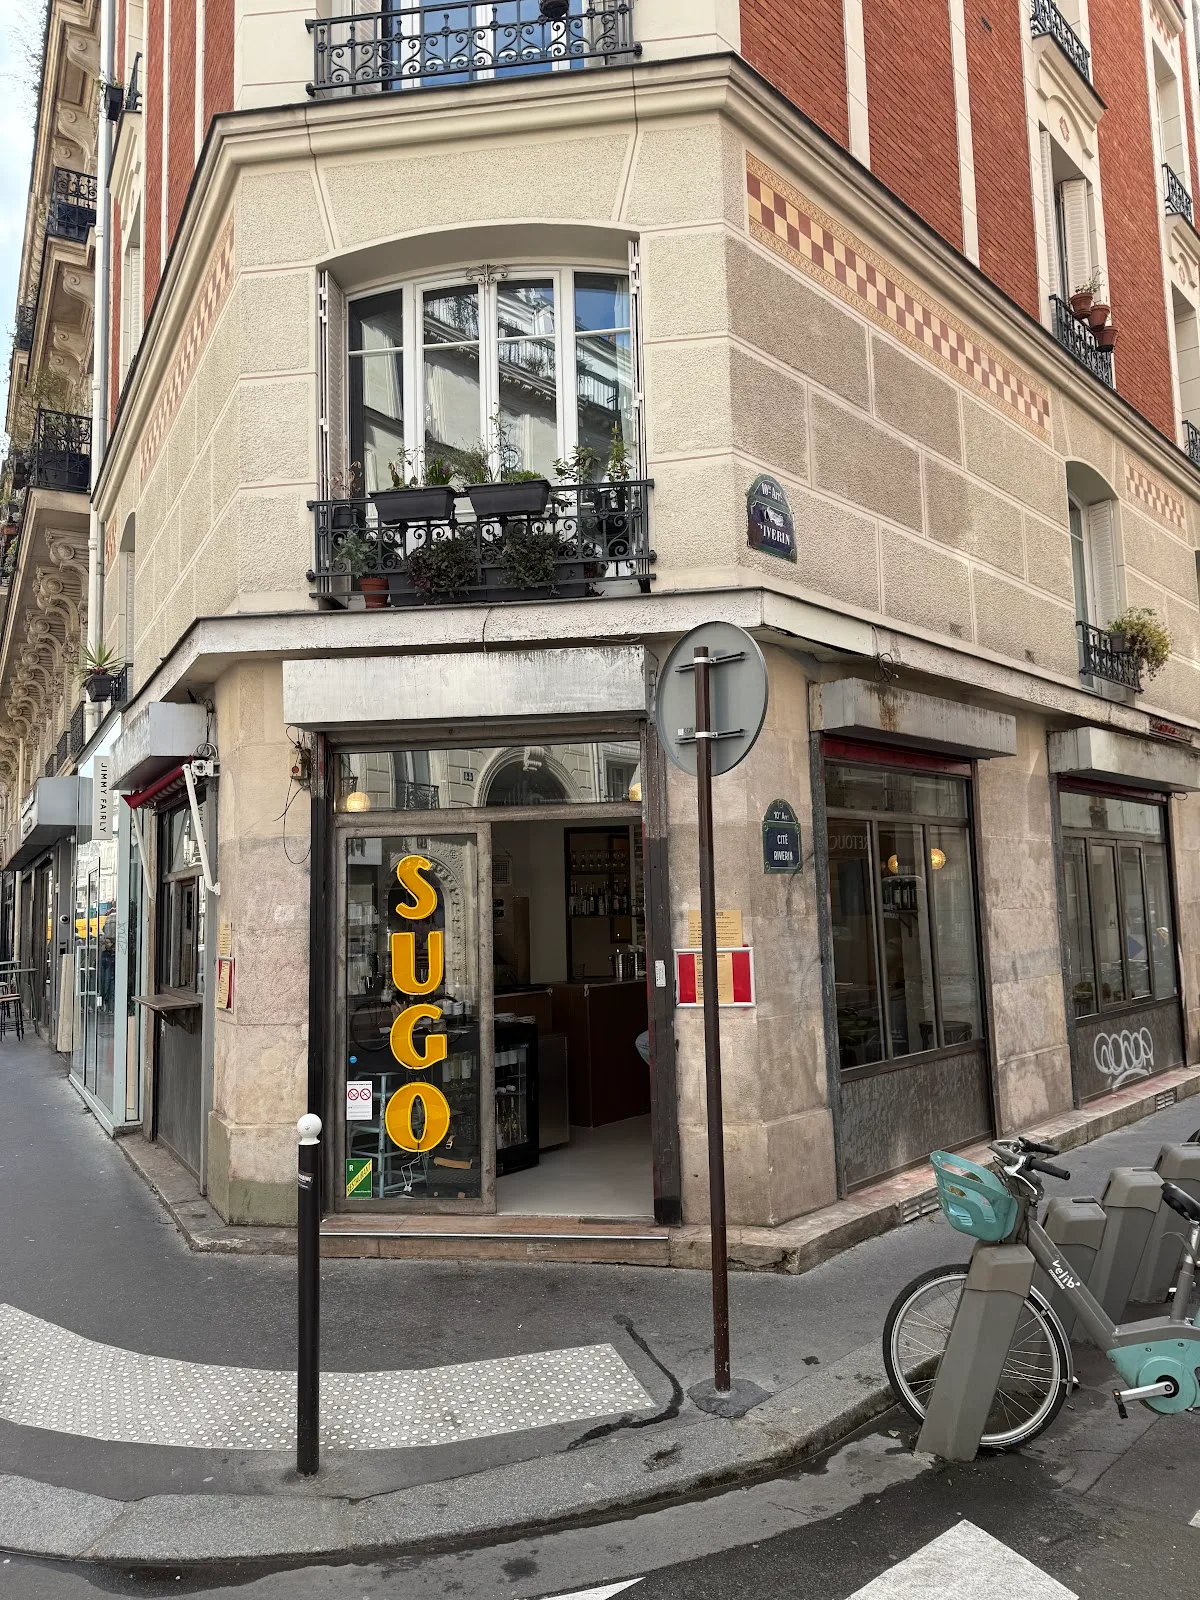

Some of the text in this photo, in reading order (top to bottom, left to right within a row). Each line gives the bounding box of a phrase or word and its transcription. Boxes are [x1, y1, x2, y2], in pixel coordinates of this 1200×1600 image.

[757, 523, 790, 545] IVERIN
[99, 762, 108, 833] JIMMY FAIRLY
[776, 833, 789, 845] CITÉ
[385, 854, 451, 1153] SUGO
[348, 1164, 354, 1172] R
